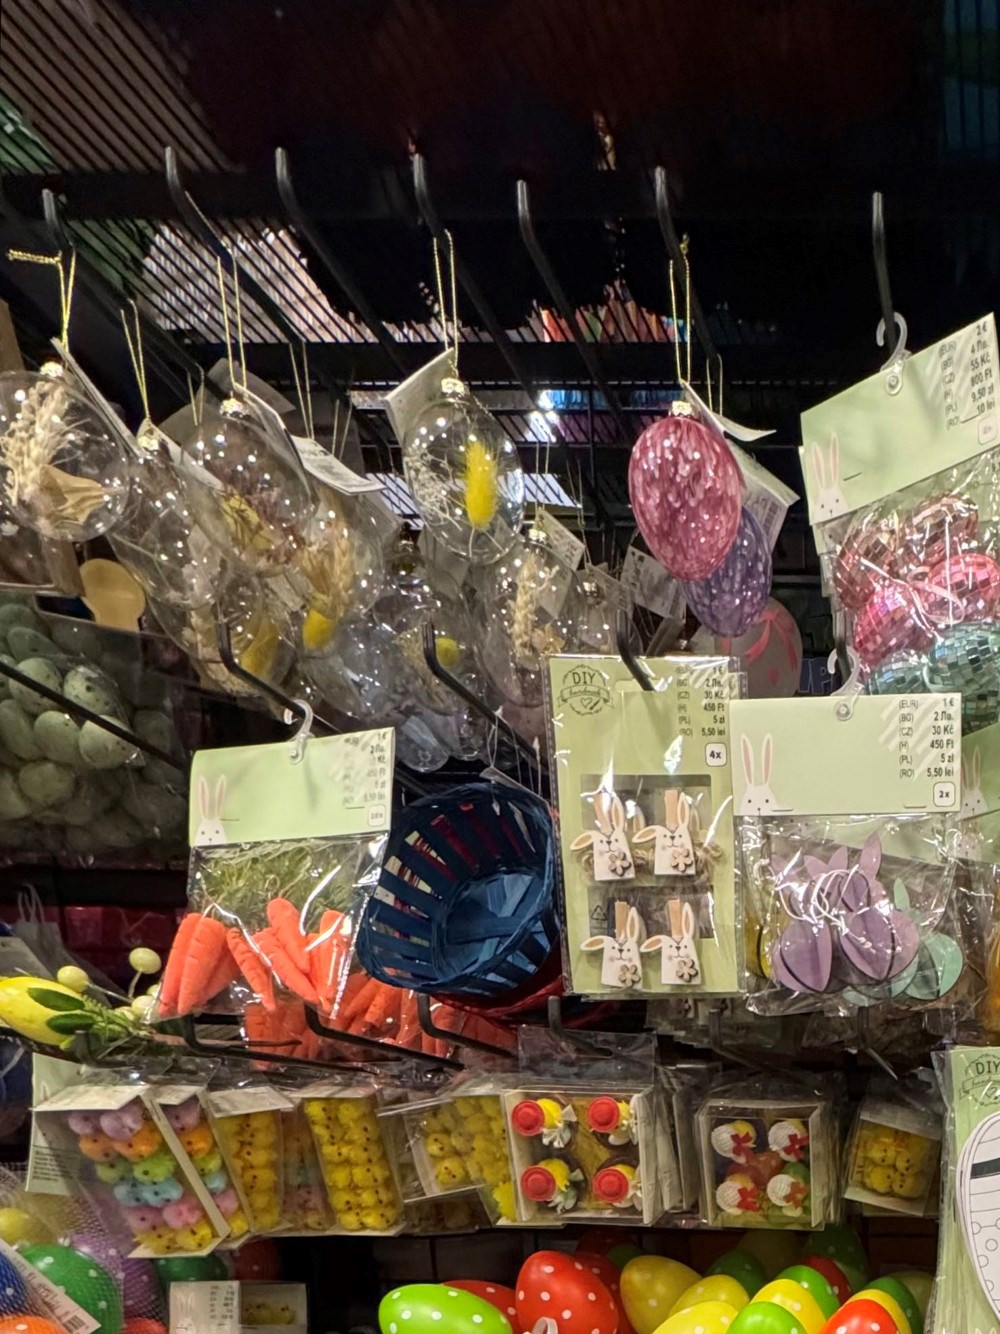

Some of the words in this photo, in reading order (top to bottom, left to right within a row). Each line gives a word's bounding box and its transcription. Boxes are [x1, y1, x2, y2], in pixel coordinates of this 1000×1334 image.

[976, 325, 981, 336] 2
[982, 321, 987, 332] €
[971, 344, 976, 354] 4
[970, 360, 979, 371] 55
[981, 352, 990, 366] Kč
[984, 368, 992, 381] Ft
[971, 386, 986, 402] 9,50
[718, 666, 724, 675] €
[572, 671, 597, 685] DIY
[706, 679, 711, 688] 2
[704, 691, 713, 700] 30
[714, 689, 725, 700] Kč
[703, 703, 716, 712] 450
[717, 703, 725, 712] Ft
[899, 699, 919, 710] (EUR)
[949, 698, 955, 707] €
[718, 716, 725, 724] zł
[899, 713, 914, 724] (BG)
[933, 711, 939, 721] 2
[701, 728, 716, 737] 5,50
[717, 727, 726, 736] lei
[899, 727, 913, 738] (CZ)
[932, 725, 941, 735] 30
[943, 724, 954, 735] Kč
[899, 741, 909, 752] (H)
[929, 739, 944, 749] 450
[946, 739, 954, 749] Ft
[899, 755, 913, 766] (PL)
[940, 753, 945, 763] 5
[947, 753, 954, 763] zł
[899, 768, 915, 780] (RO)
[926, 767, 943, 779] 5,50
[944, 766, 954, 777] lei
[975, 1061, 1000, 1075] DIY
